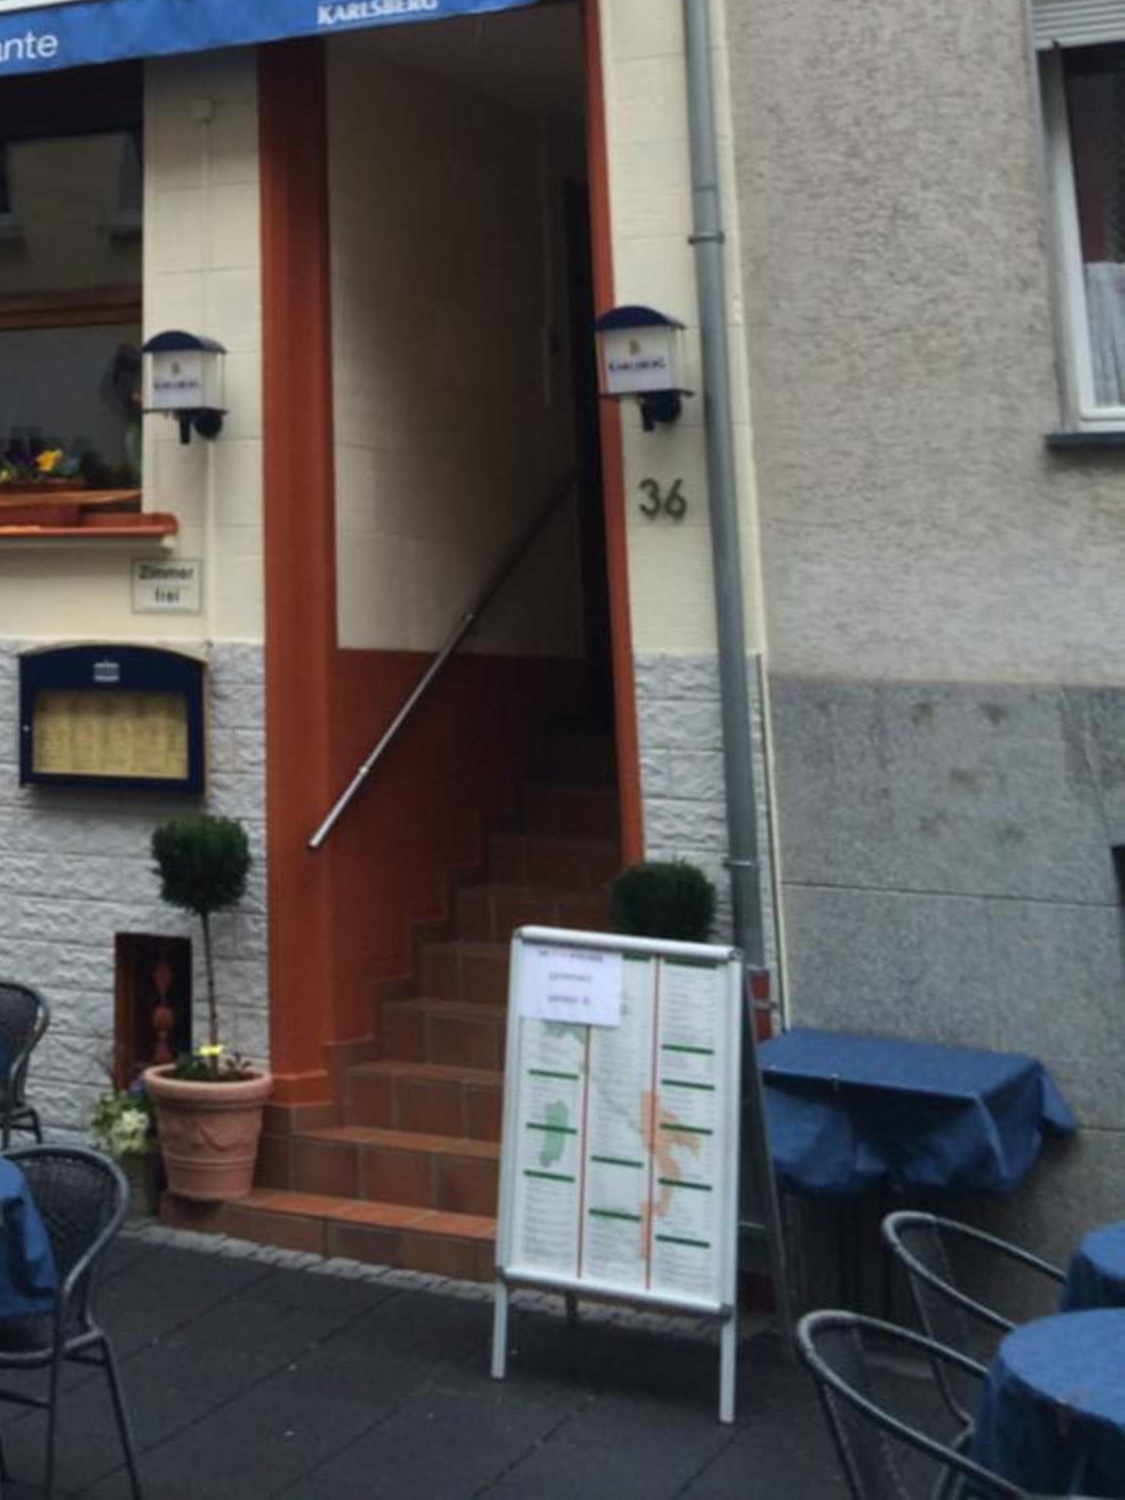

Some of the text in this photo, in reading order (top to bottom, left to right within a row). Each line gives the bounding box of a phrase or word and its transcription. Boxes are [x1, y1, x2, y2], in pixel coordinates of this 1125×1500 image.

[638, 477, 688, 521] 36
[138, 564, 194, 581] Zimmer
[154, 586, 181, 604] frei
